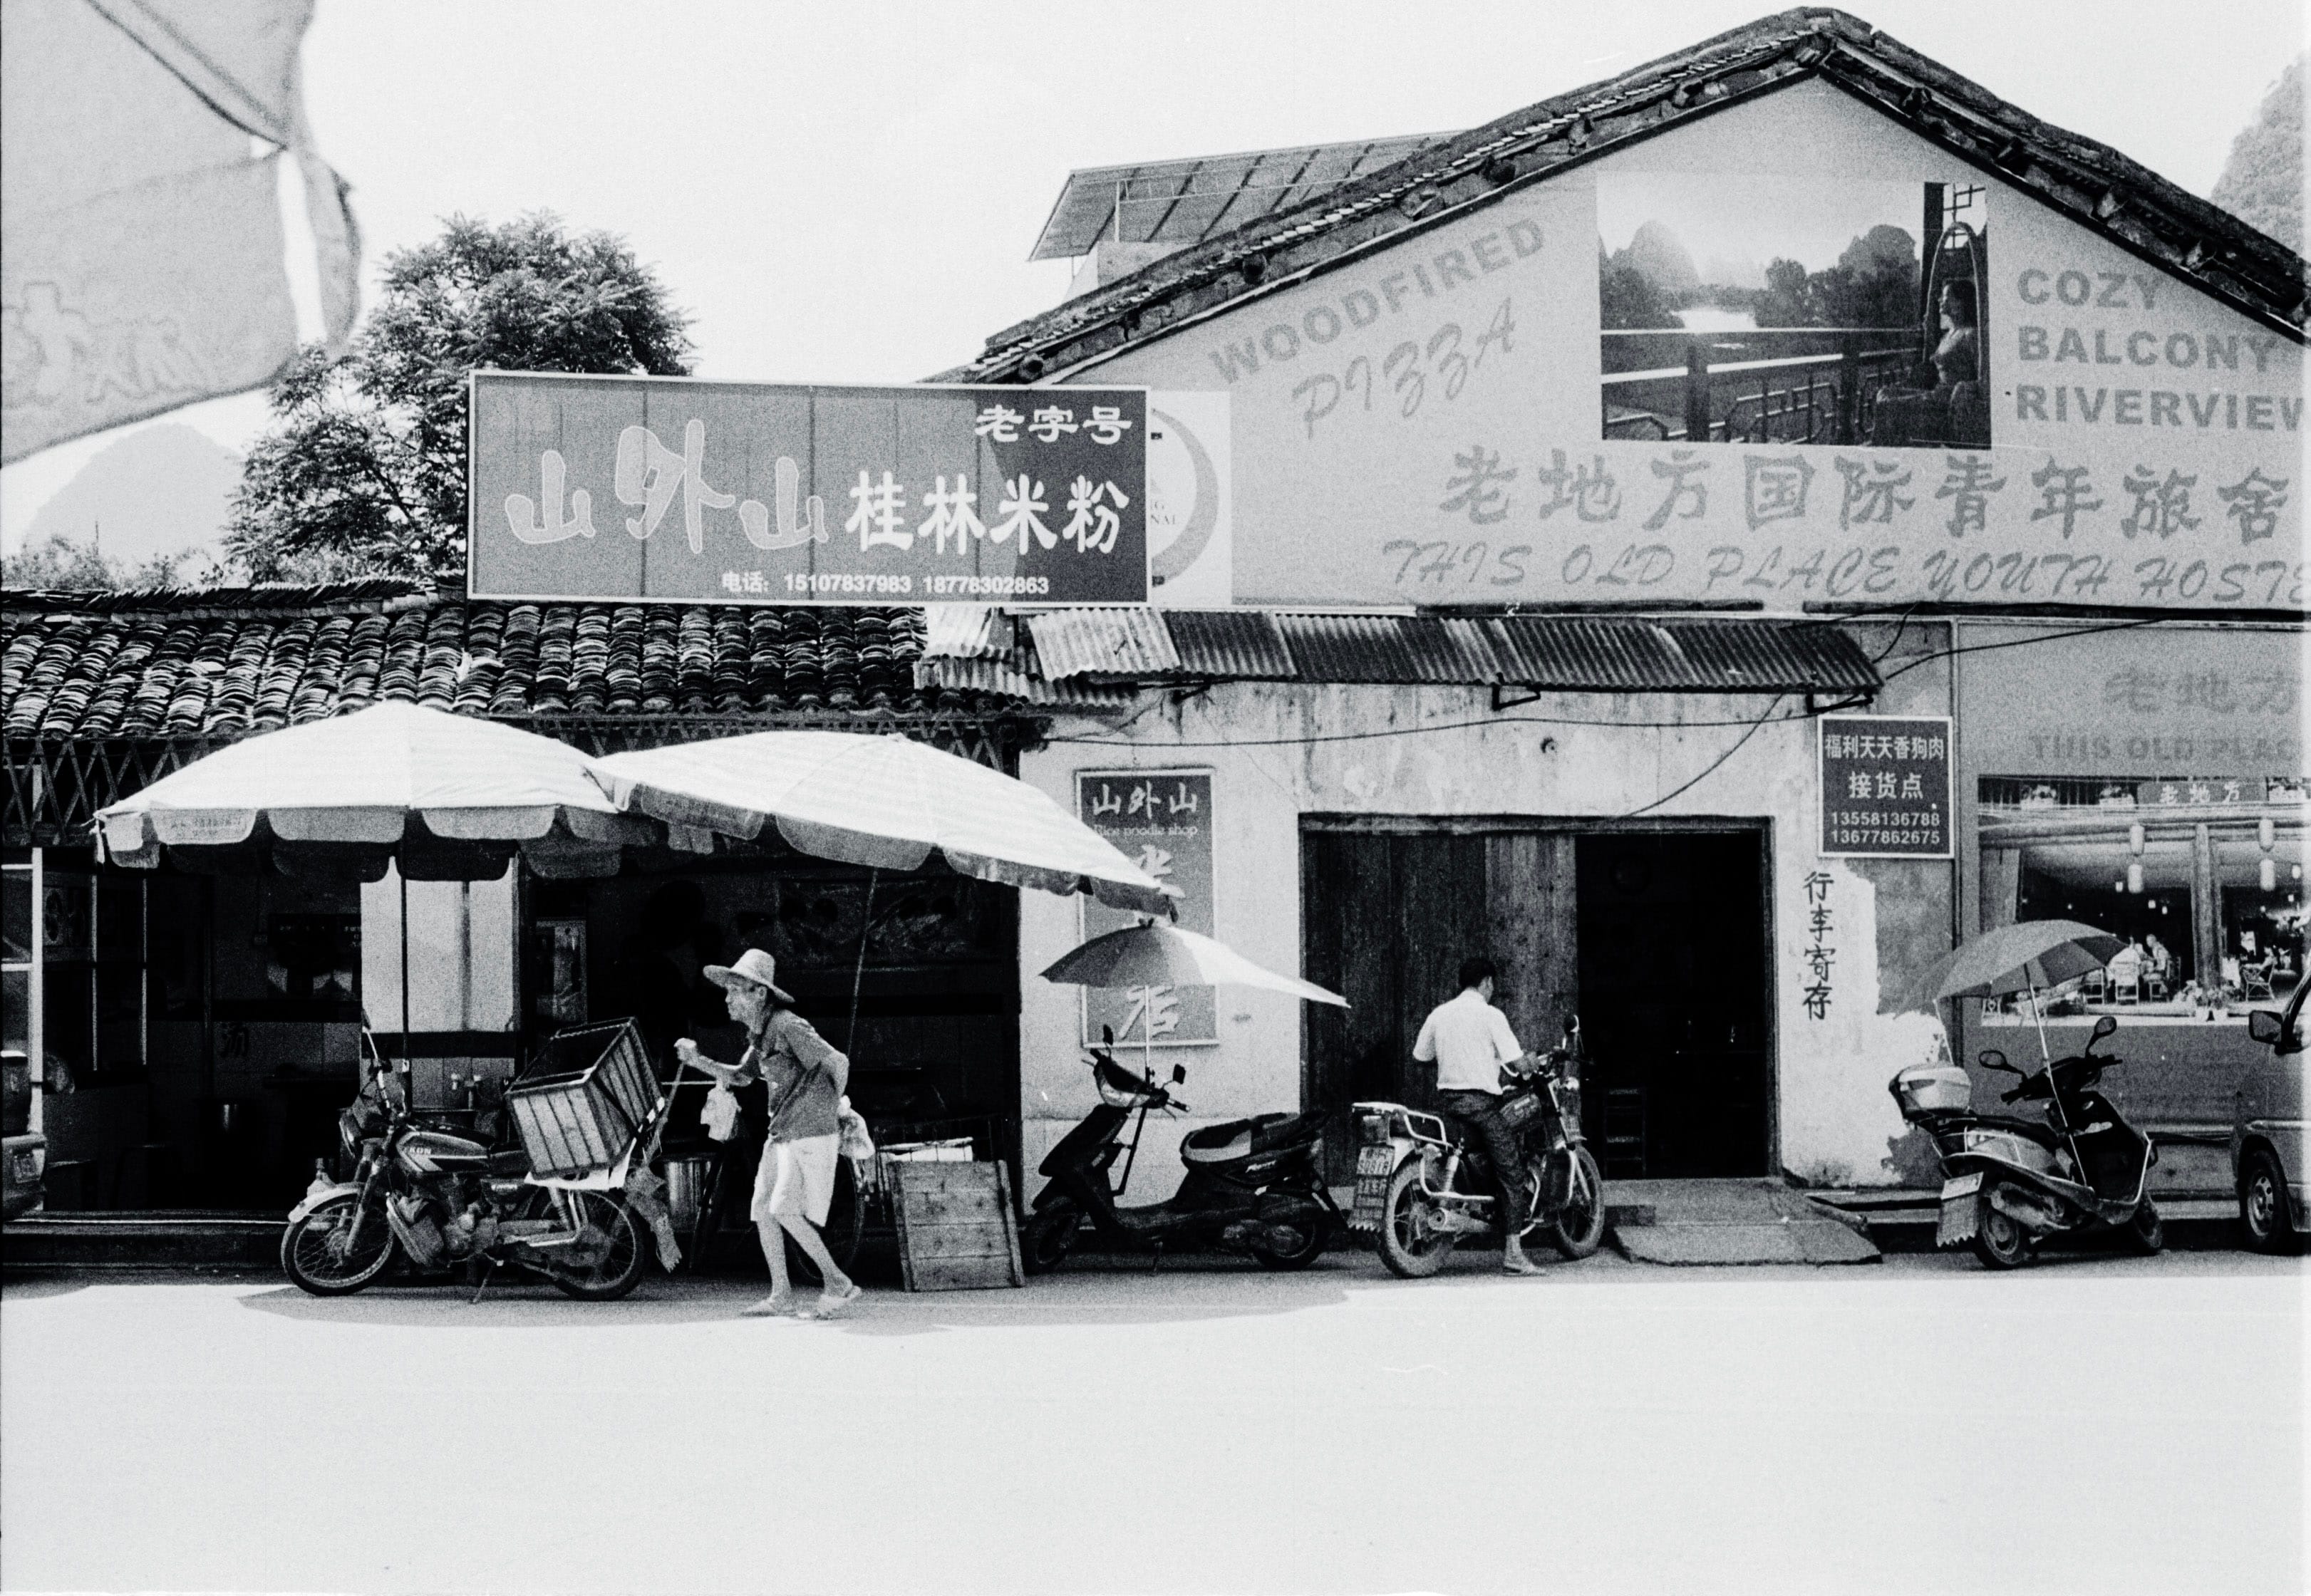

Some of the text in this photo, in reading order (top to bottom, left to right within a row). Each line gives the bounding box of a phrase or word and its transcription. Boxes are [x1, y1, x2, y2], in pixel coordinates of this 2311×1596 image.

[1211, 218, 1545, 383] WOODFIRED
[2017, 269, 2163, 310] COZY
[1292, 296, 1516, 440] PIZZA
[2018, 326, 2277, 372] BALCONY
[975, 405, 1132, 445] 老字号
[505, 419, 1129, 555] 山外山 桂林米粉
[1439, 444, 2289, 546] 老地方国际青年旅舍
[784, 574, 912, 594] 15107837983
[926, 576, 1050, 595] 18778302863
[1382, 539, 1532, 586] THIS
[1561, 543, 1675, 586] OLD
[1707, 544, 1900, 597] PLACE
[1923, 548, 2109, 603] YOUTH
[1825, 735, 1944, 760] 福利天天香狗肉
[2029, 735, 2111, 760] THIS
[2126, 736, 2194, 761] OLD
[1093, 780, 1197, 819] 山外山
[1849, 771, 1923, 799] 接货点
[1168, 823, 1198, 839] shop
[1831, 812, 1940, 826] 13558136788
[1831, 829, 1940, 844] 13677862675
[1802, 871, 1836, 1021] 行李寄存
